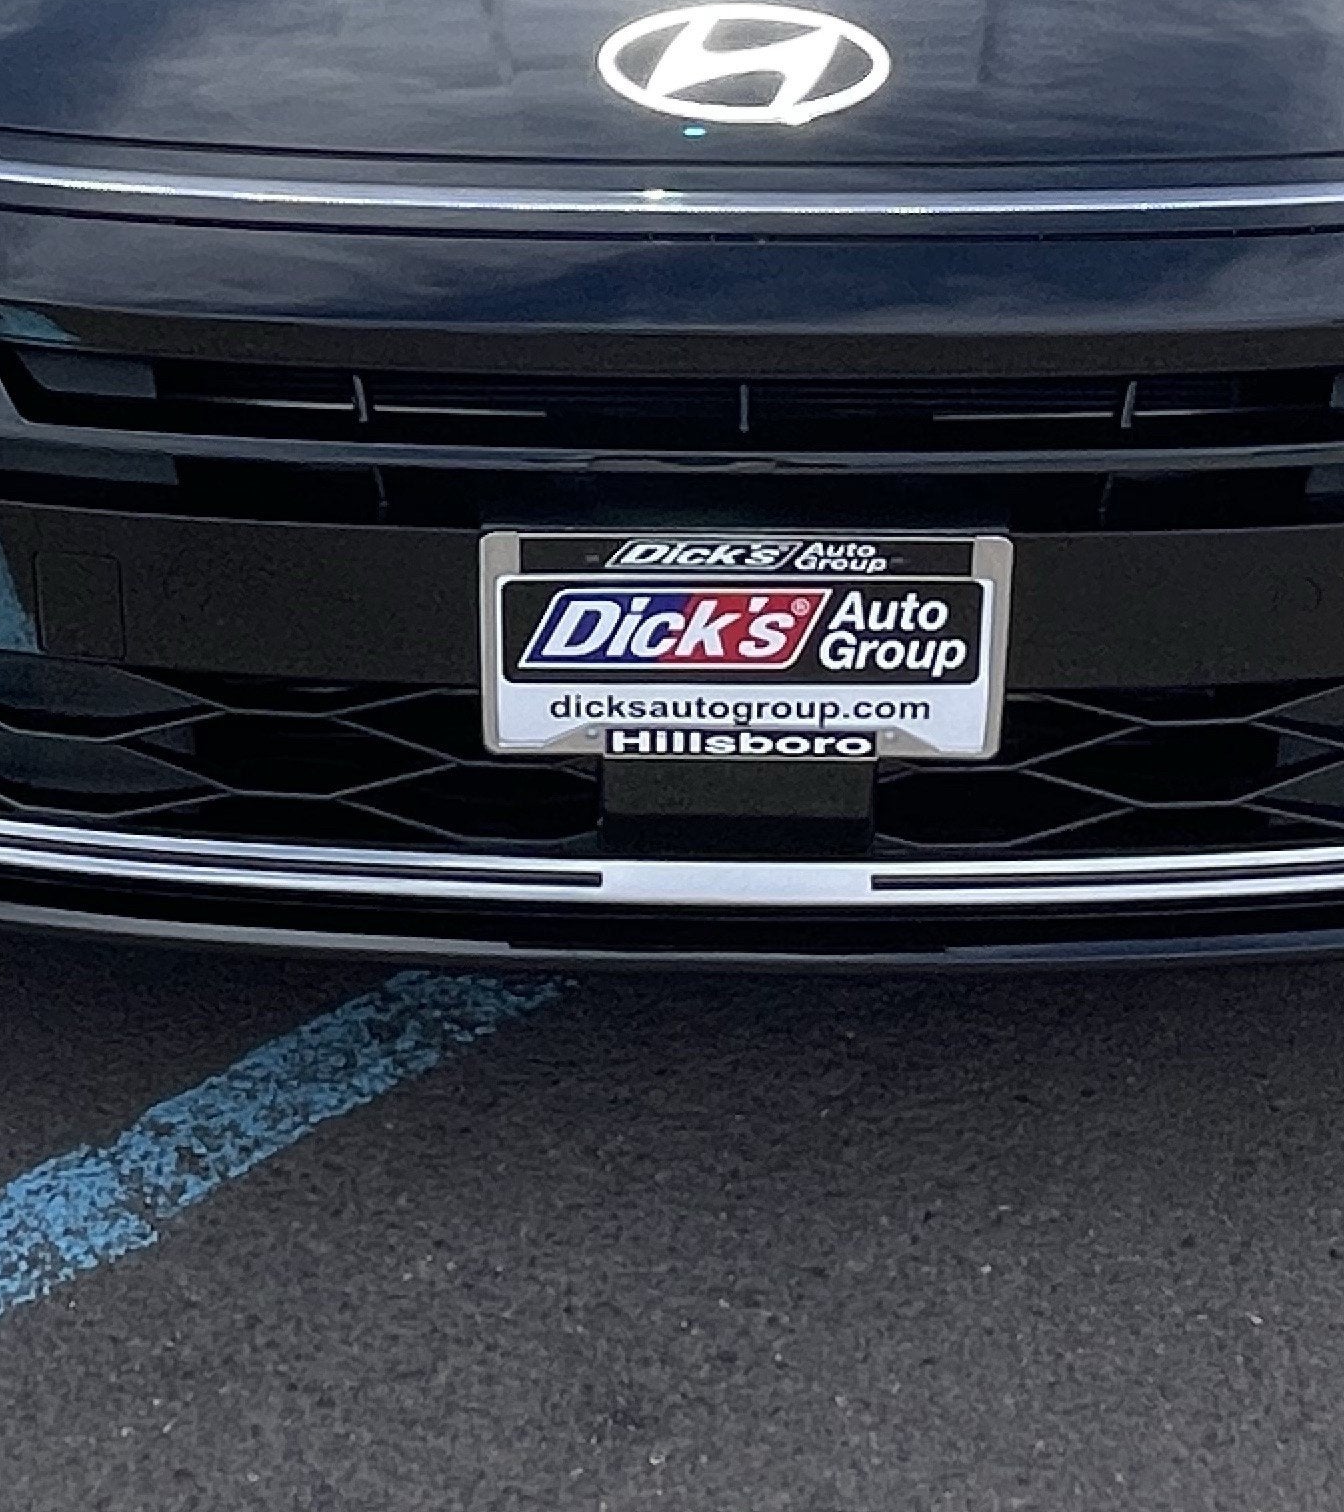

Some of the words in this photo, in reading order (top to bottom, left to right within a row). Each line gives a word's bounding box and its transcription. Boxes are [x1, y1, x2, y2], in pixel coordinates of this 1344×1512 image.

[805, 542, 877, 558] Auto
[794, 557, 887, 574] Group
[541, 596, 796, 658] Dick's
[828, 591, 948, 632] Auto
[819, 632, 966, 677] Group
[550, 695, 931, 728] dicksautogroup.com
[612, 730, 872, 756] Hillsboro
